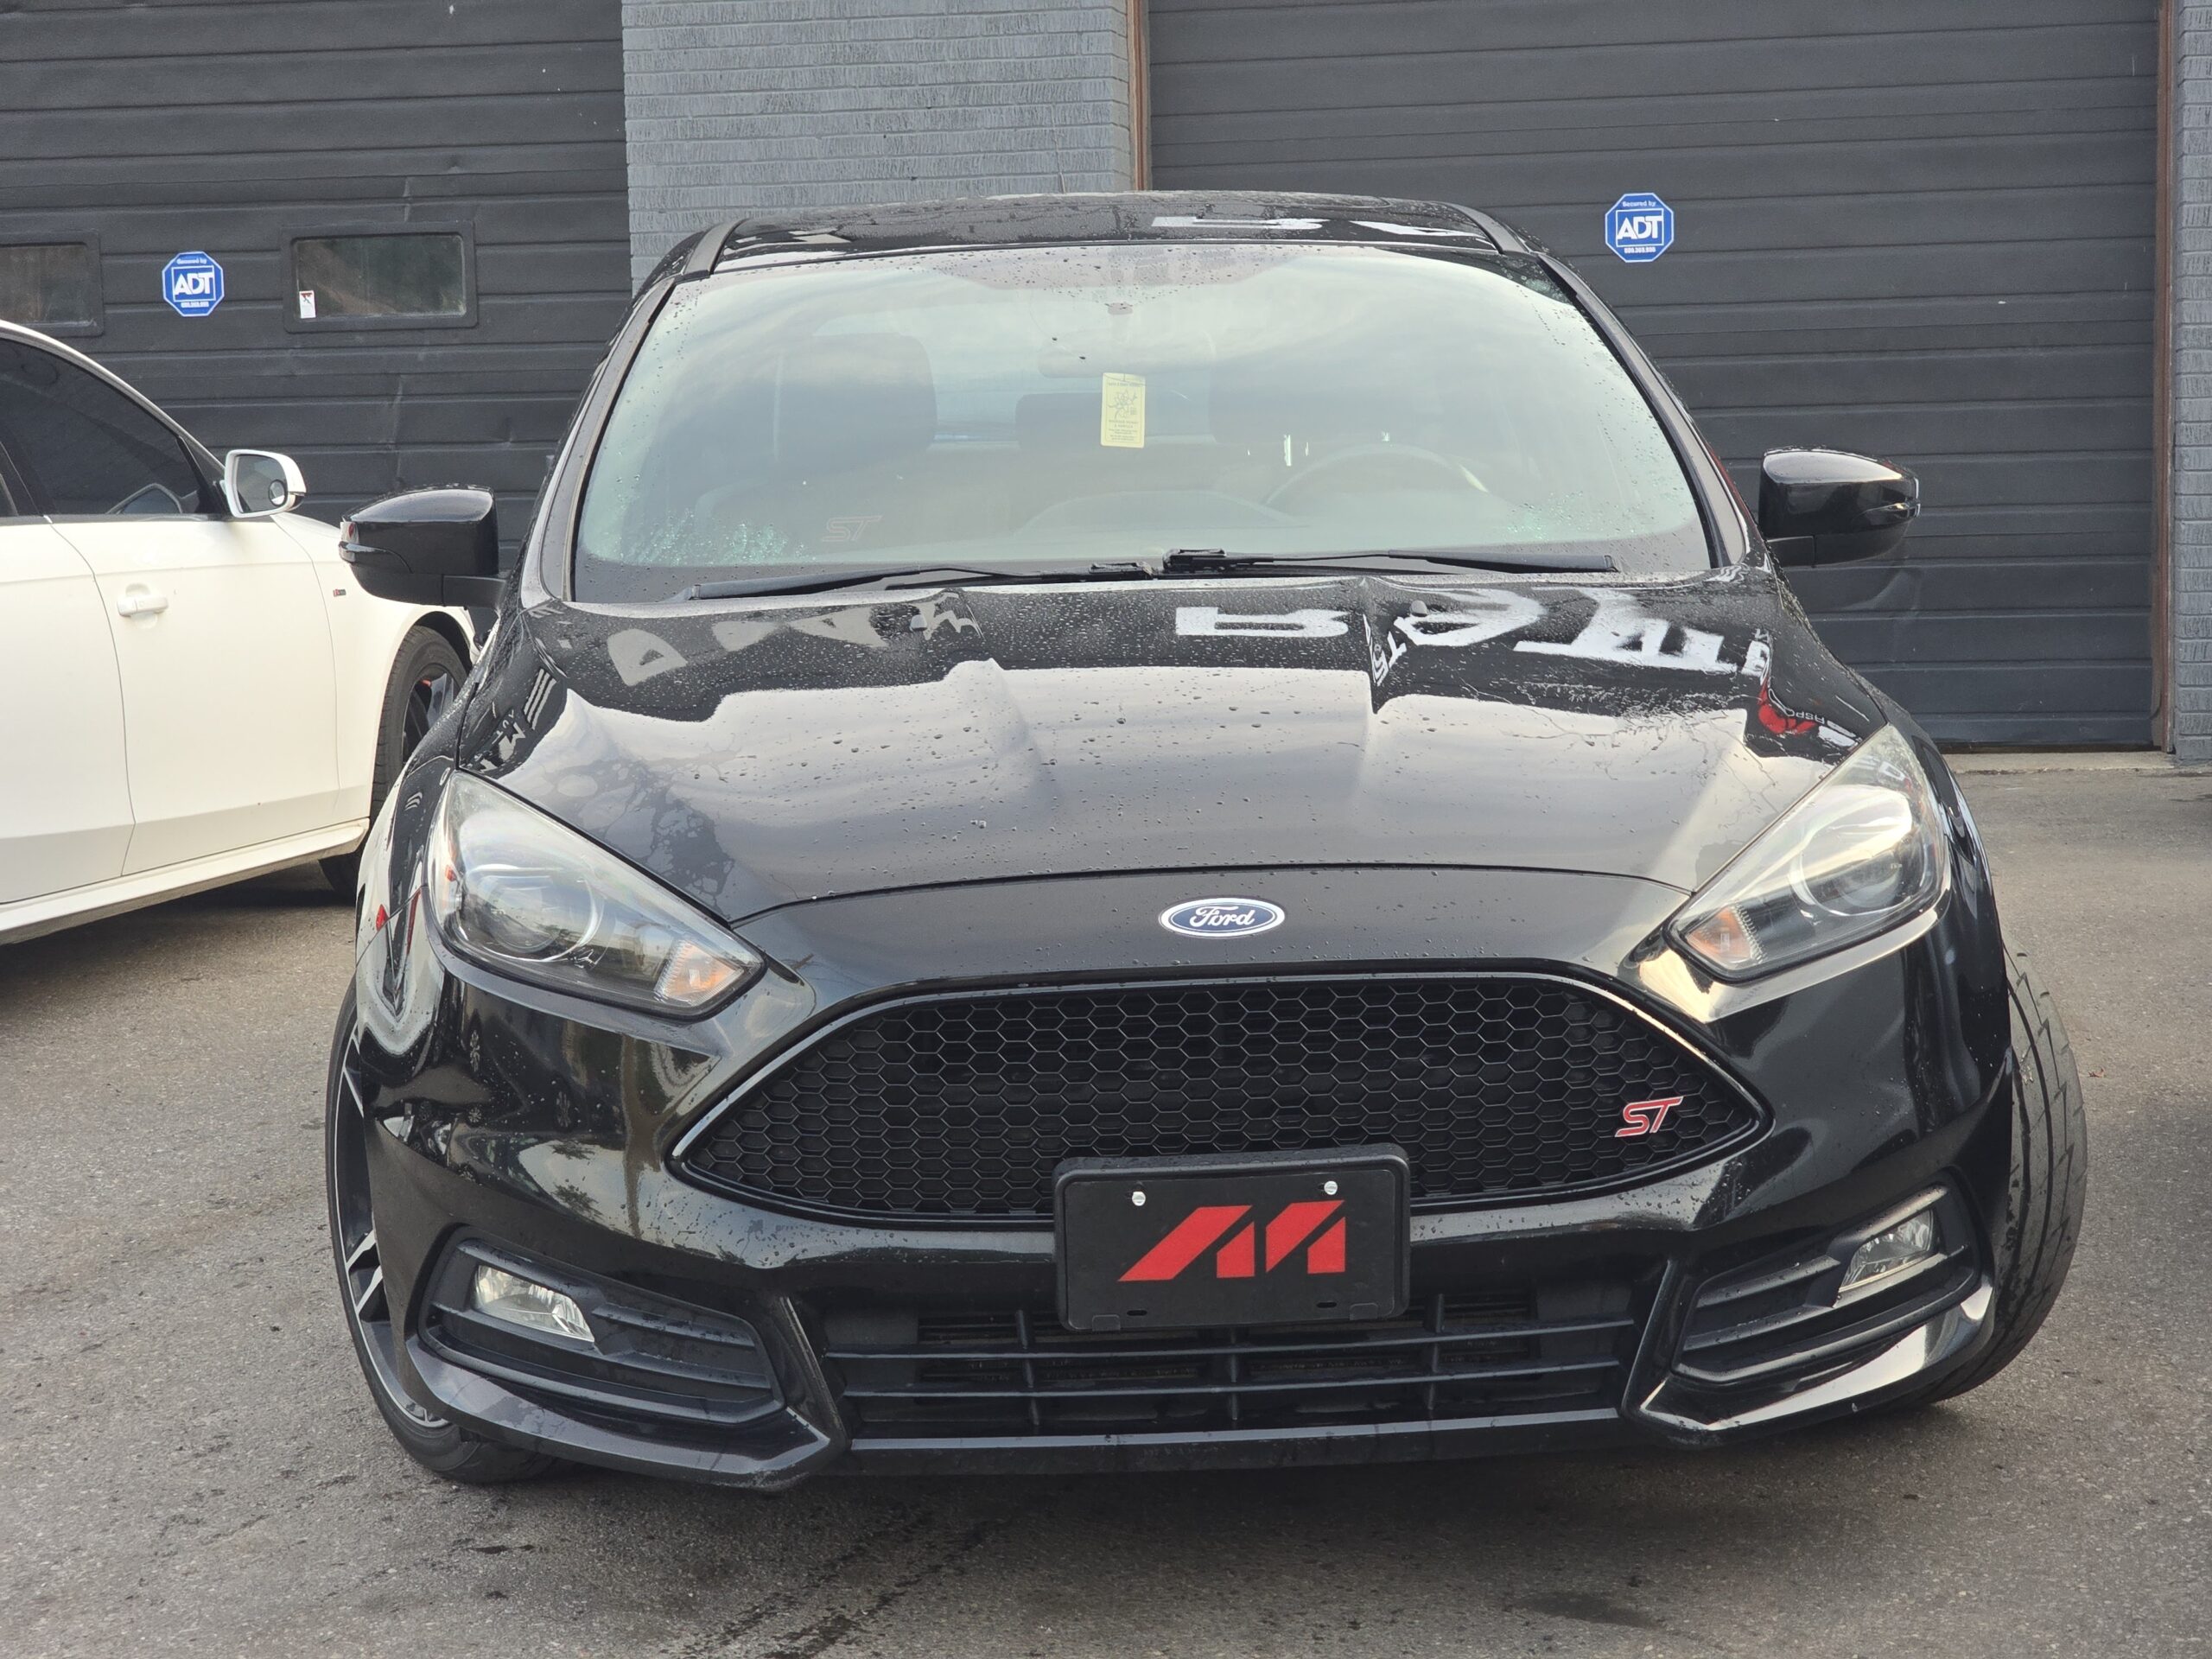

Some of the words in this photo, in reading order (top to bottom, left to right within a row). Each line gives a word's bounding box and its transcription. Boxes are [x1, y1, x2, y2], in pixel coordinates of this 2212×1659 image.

[1618, 215, 1662, 239] ADT
[174, 272, 213, 296] ADT
[1189, 906, 1255, 927] Ford
[1614, 1096, 1684, 1137] ST
